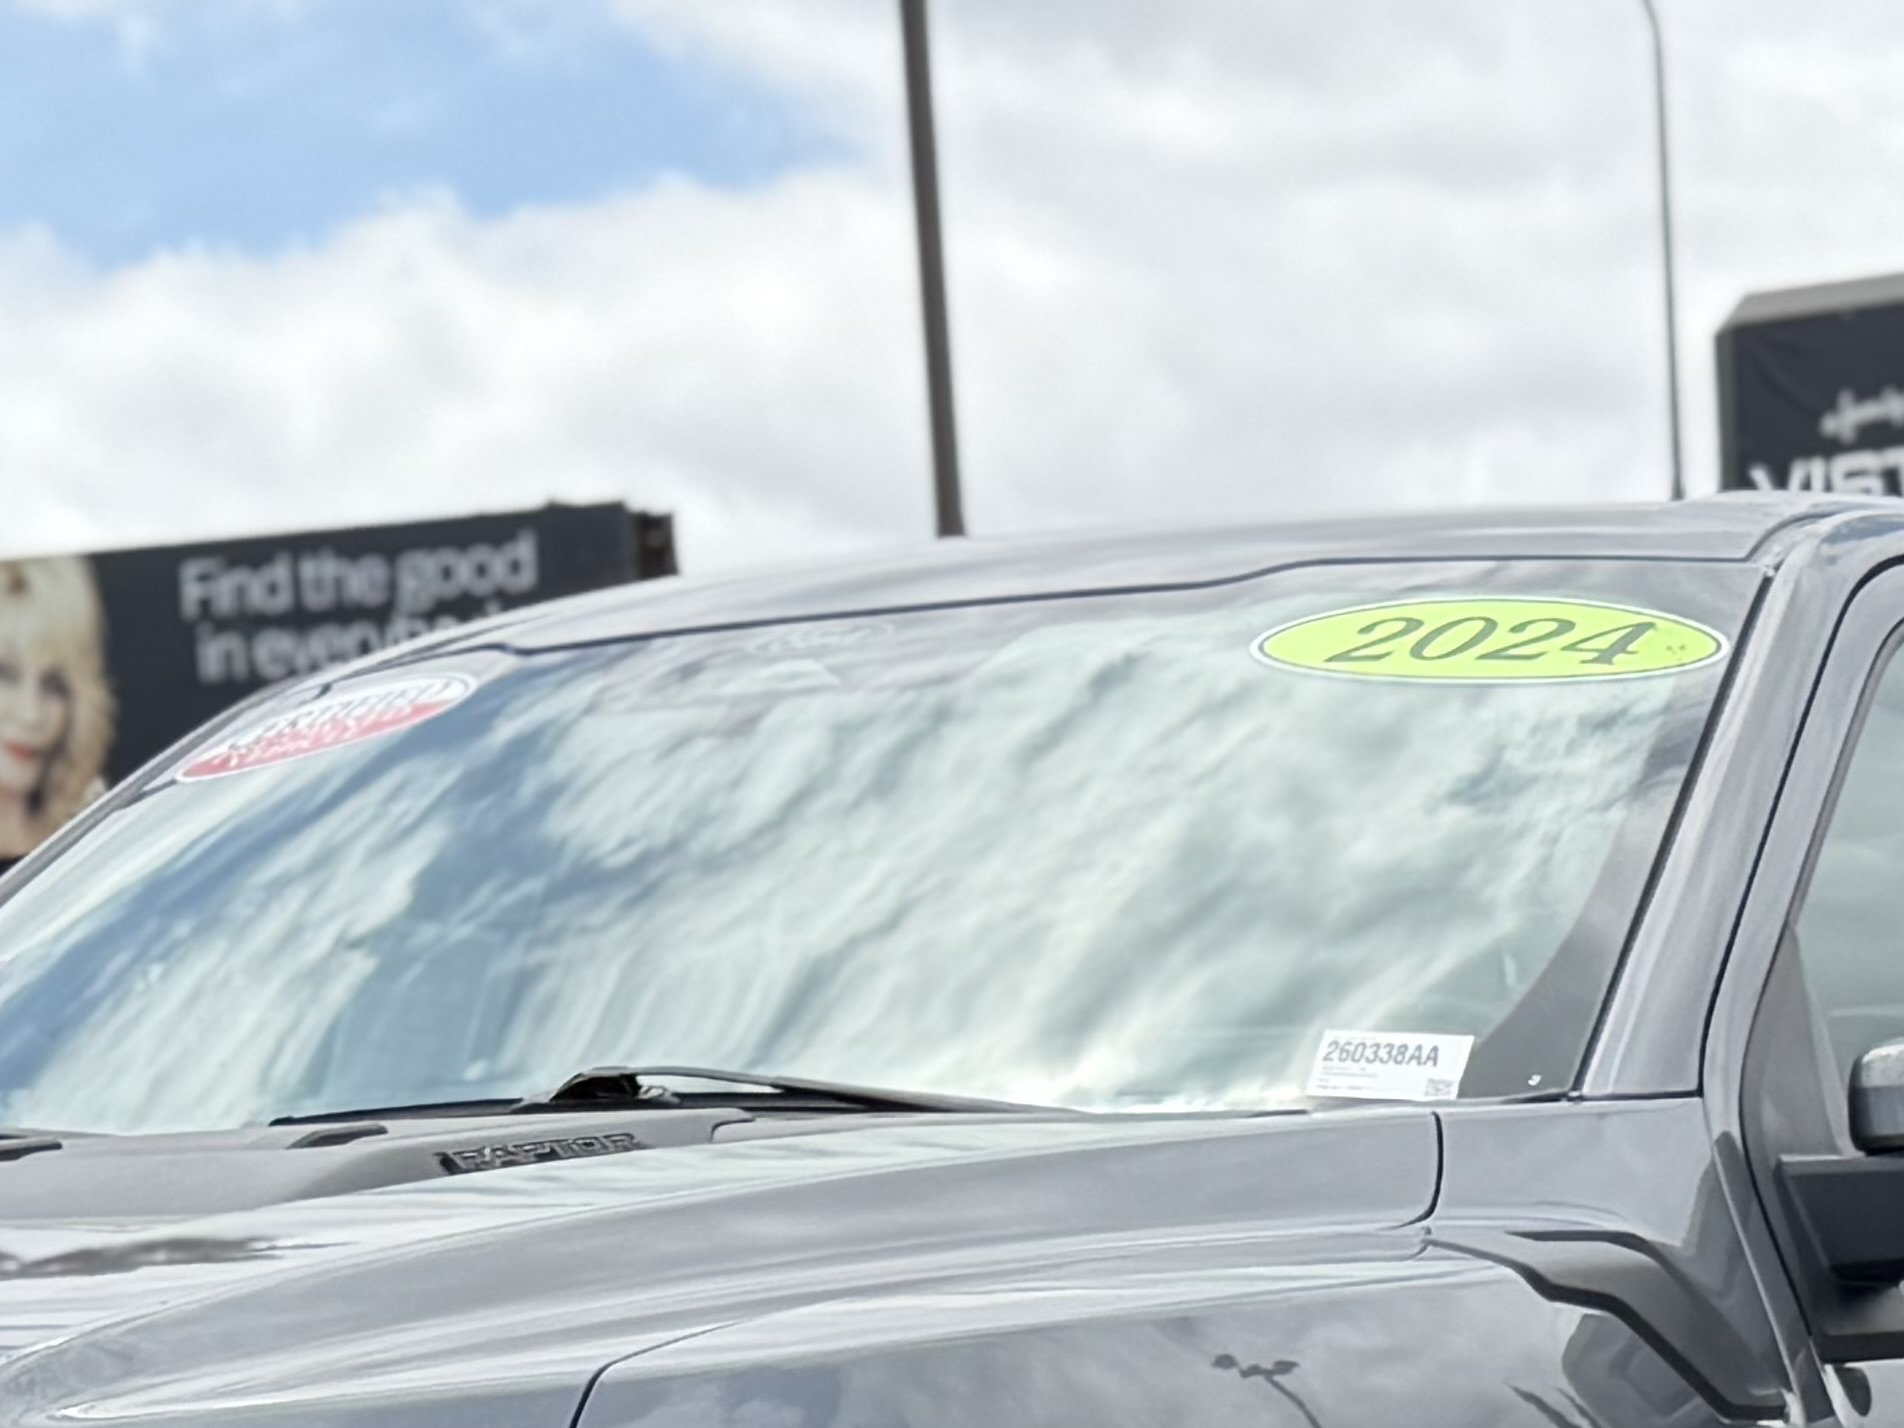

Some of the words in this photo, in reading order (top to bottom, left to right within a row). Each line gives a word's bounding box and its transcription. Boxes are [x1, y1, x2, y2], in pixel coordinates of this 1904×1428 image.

[178, 552, 294, 622] Find
[298, 549, 390, 611] the
[394, 528, 539, 616] good
[195, 620, 250, 684] in
[1322, 616, 1660, 665] 2024
[1322, 1040, 1440, 1067] 260338AA
[437, 1132, 644, 1174] RAPTOR
